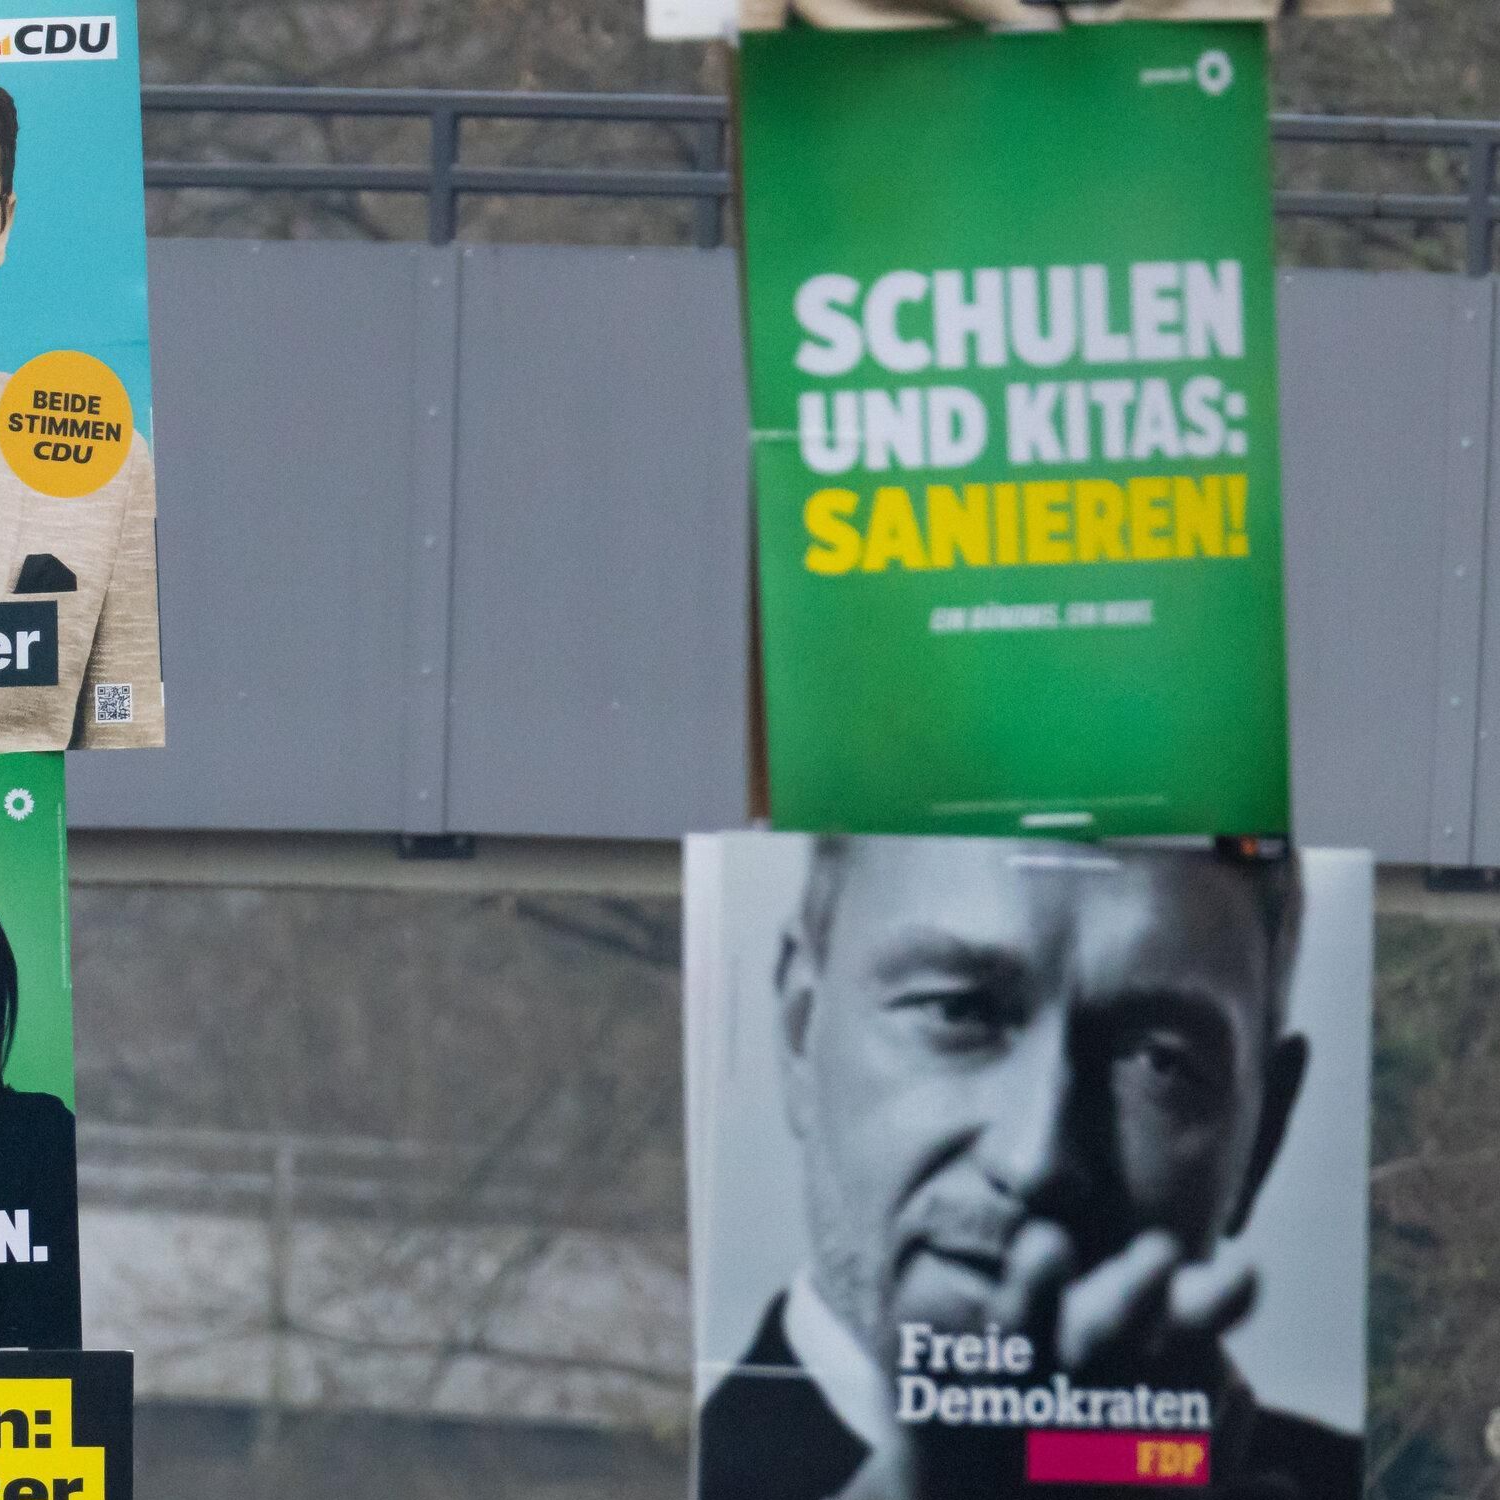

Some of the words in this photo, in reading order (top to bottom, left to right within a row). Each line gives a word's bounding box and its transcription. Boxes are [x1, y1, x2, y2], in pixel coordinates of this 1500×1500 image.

[13, 22, 111, 55] CDU
[794, 260, 1244, 376] SCHULEN
[32, 389, 101, 417] BEIDE
[798, 386, 988, 474] UND
[1006, 376, 1247, 465] KITAS:
[7, 413, 122, 444] STIMMEN
[33, 441, 93, 465] CDU
[804, 474, 1249, 576] SANIEREN!
[899, 1323, 1033, 1374] Freie
[898, 1375, 1210, 1427] Demokraten
[1135, 1440, 1205, 1479] FDP
